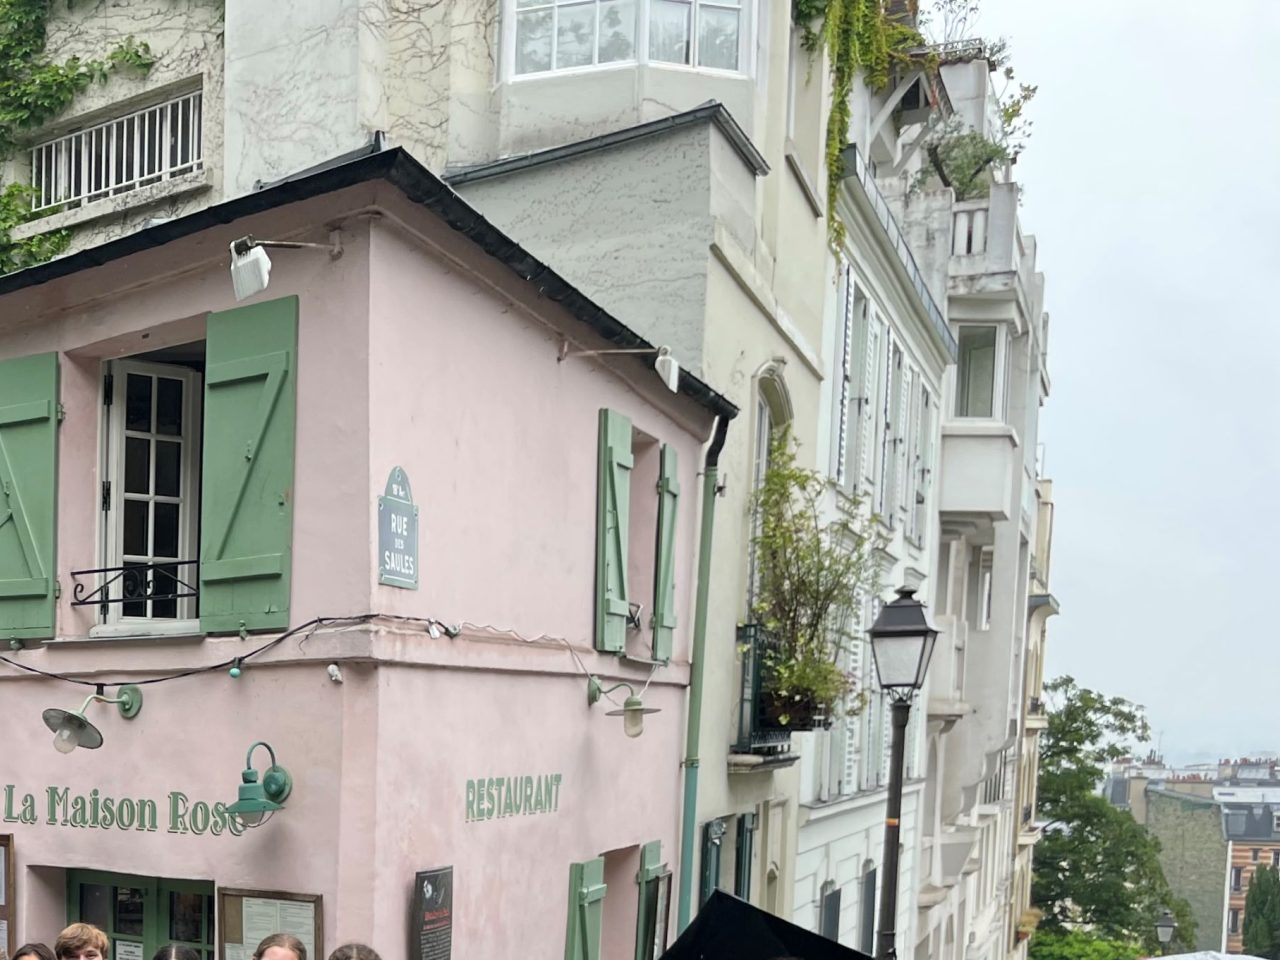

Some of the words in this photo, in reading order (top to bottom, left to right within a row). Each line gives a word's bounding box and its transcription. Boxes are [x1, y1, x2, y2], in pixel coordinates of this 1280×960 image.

[391, 513, 408, 536] RUE
[384, 550, 414, 575] SAULES
[4, 784, 37, 824] La
[46, 785, 158, 830] Maison
[465, 773, 562, 823] RESTAURANT
